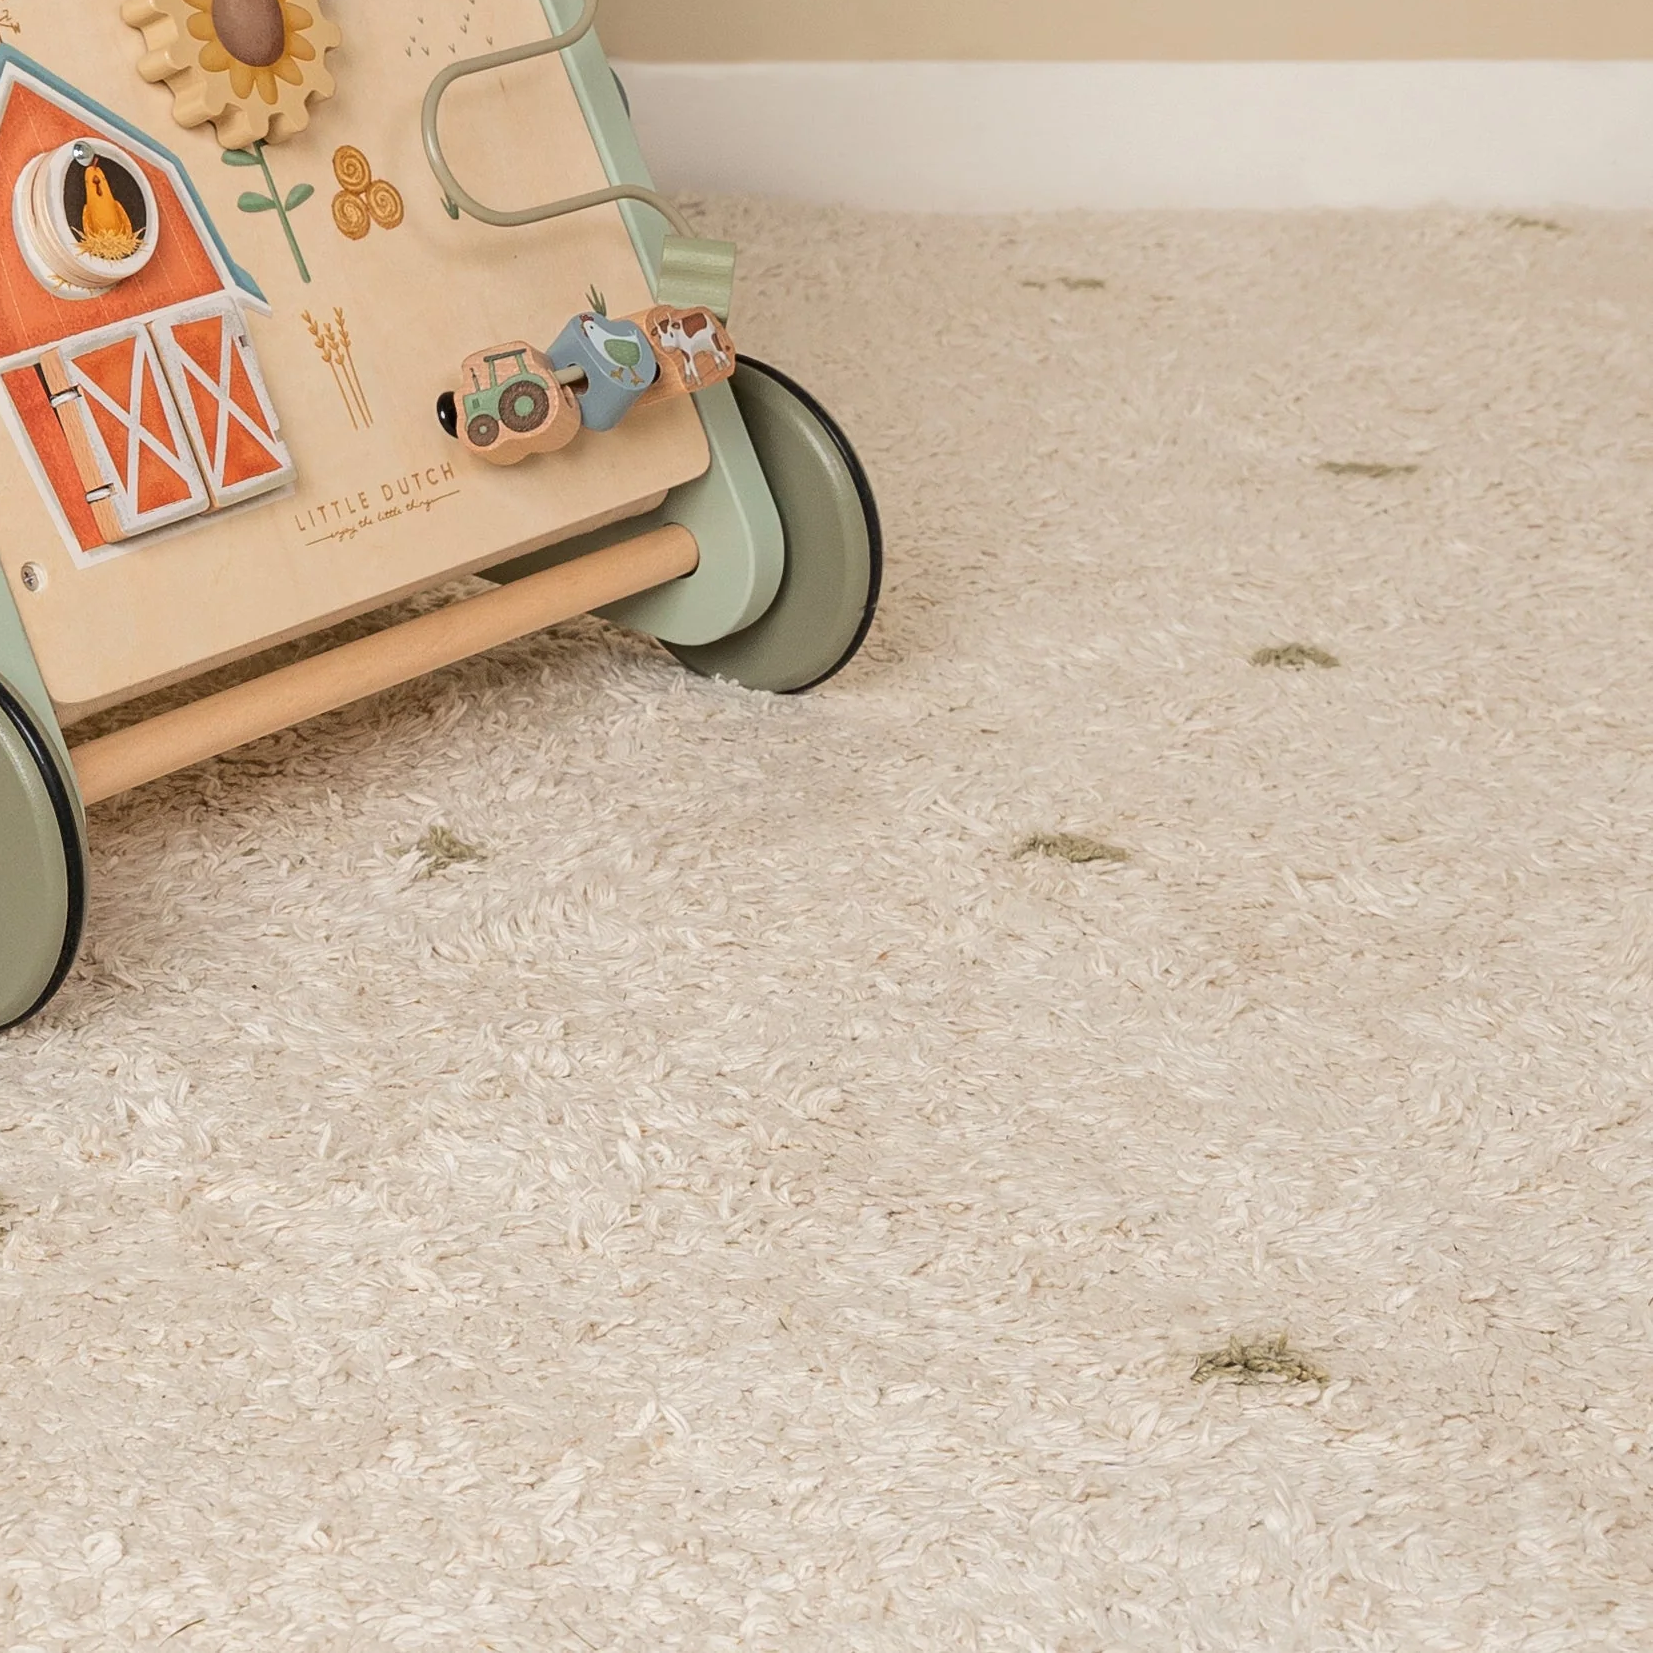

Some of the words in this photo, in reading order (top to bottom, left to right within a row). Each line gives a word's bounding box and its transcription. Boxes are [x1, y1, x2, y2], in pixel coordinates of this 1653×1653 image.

[294, 491, 370, 532] LITTLE
[380, 461, 455, 501] DUTCH
[358, 515, 374, 528] the
[377, 506, 403, 522] little
